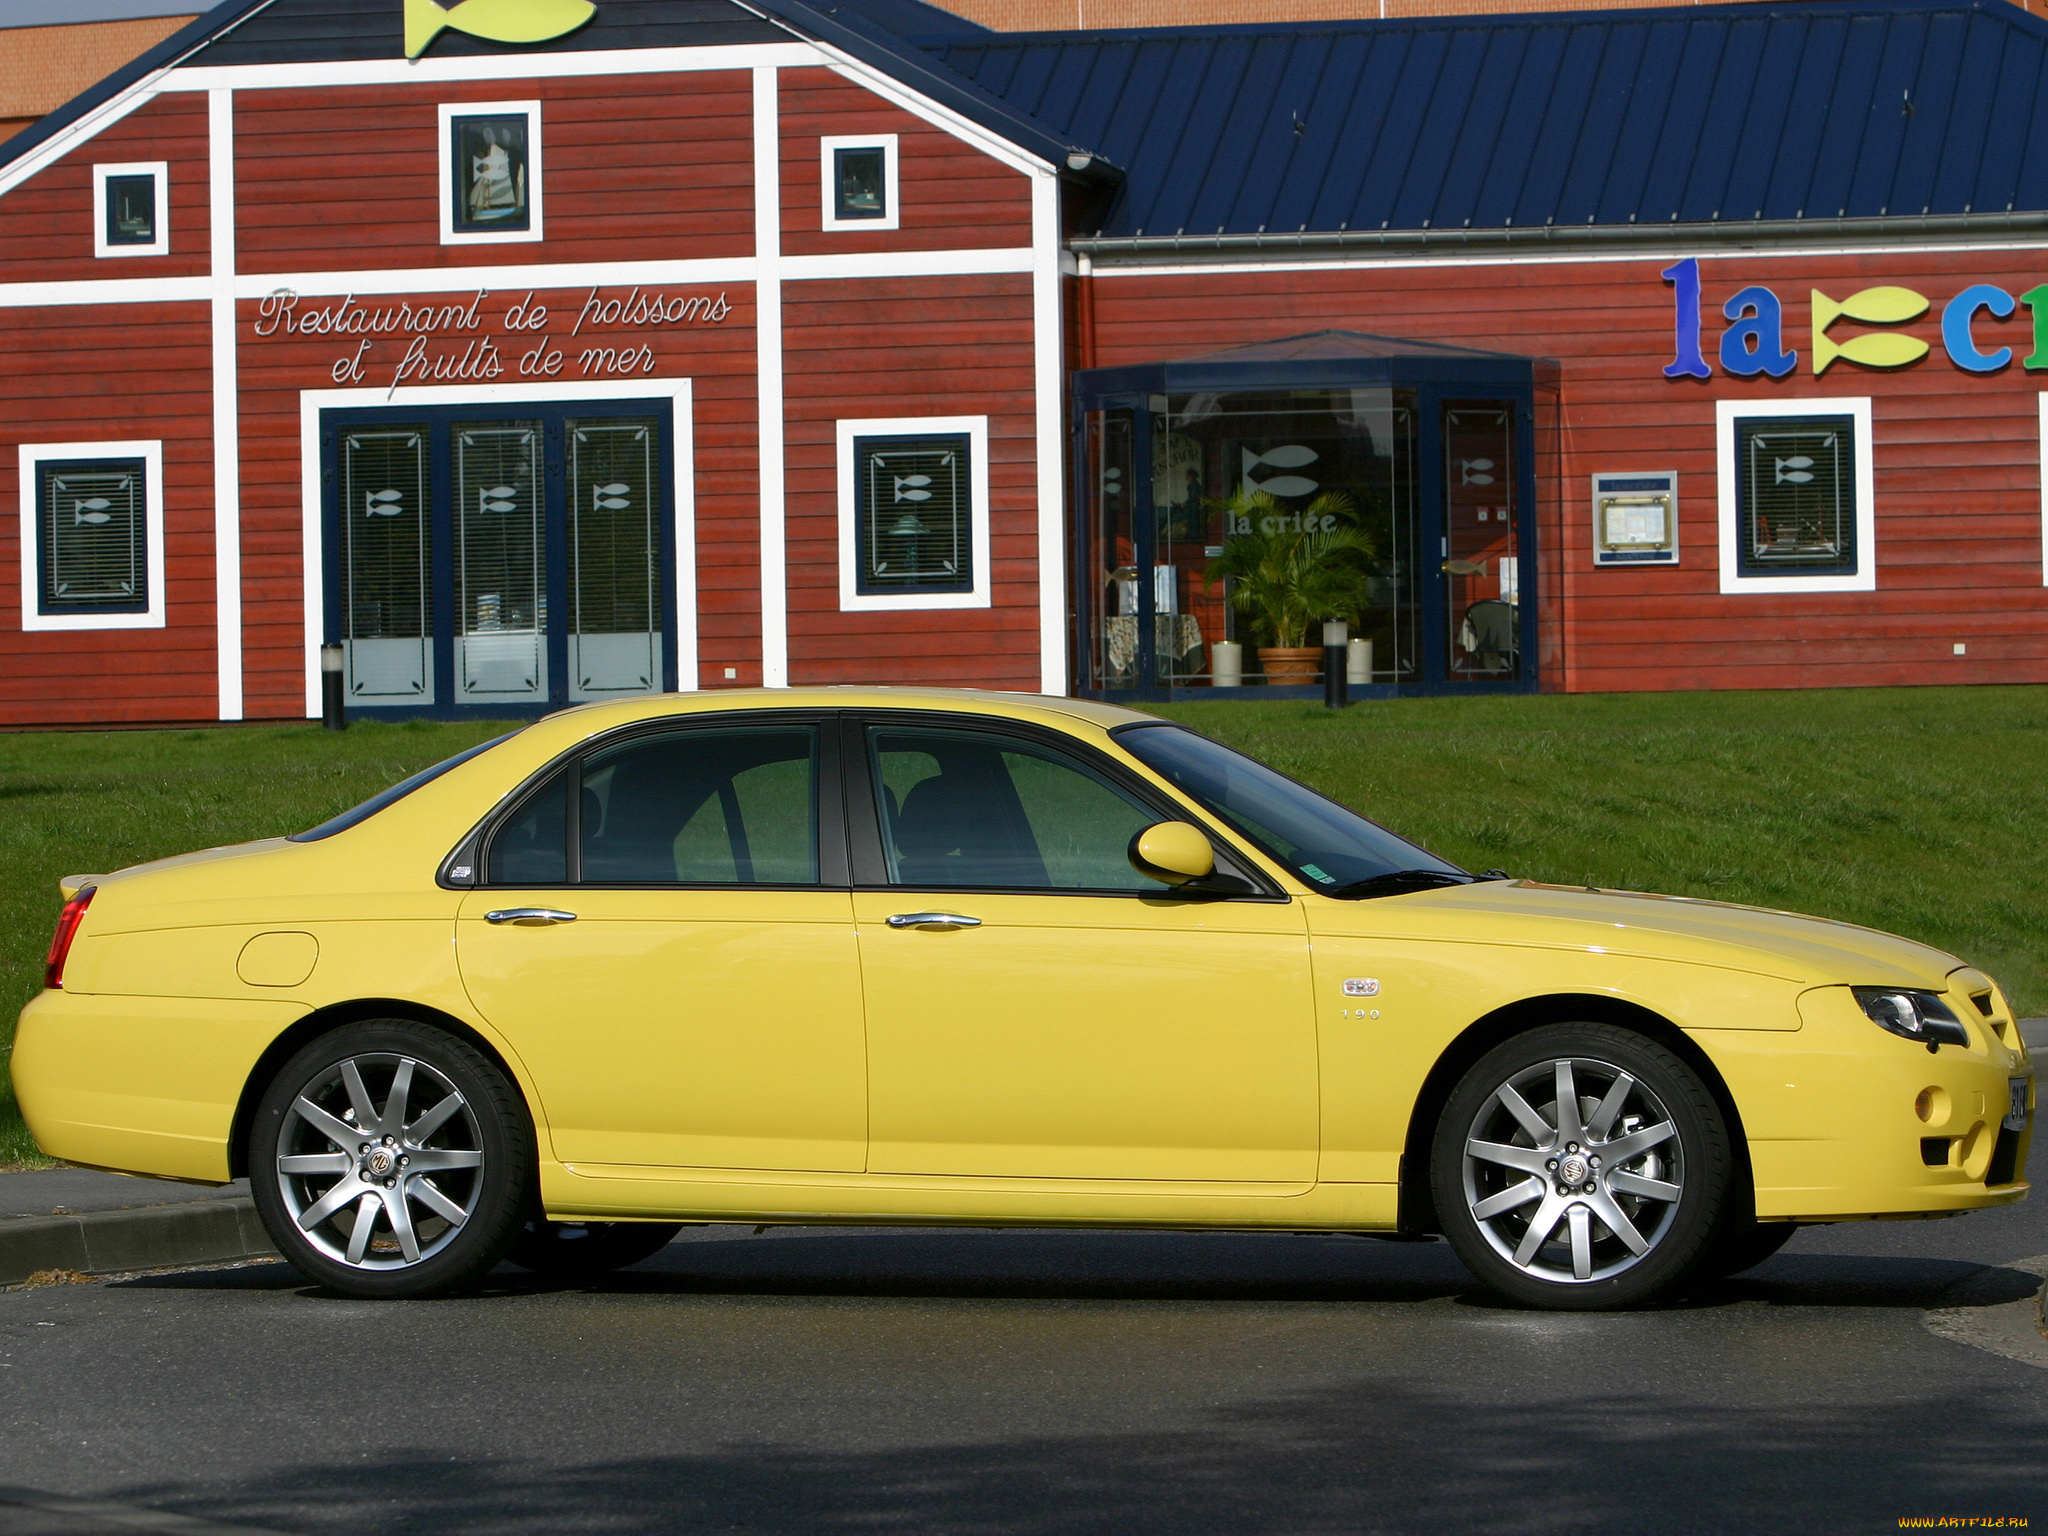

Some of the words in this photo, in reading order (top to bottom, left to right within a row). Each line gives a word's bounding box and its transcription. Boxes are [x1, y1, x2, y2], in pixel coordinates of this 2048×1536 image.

[254, 287, 490, 336] Restaurant
[504, 290, 549, 331] de
[1661, 257, 1797, 379] la
[331, 338, 373, 384] et
[387, 335, 505, 402] fruits
[519, 335, 564, 376] de
[578, 343, 656, 375] mer
[1227, 509, 1253, 536] la
[1260, 510, 1337, 535] criée
[1341, 1009, 1380, 1020] 190
[372, 1153, 389, 1170] MG
